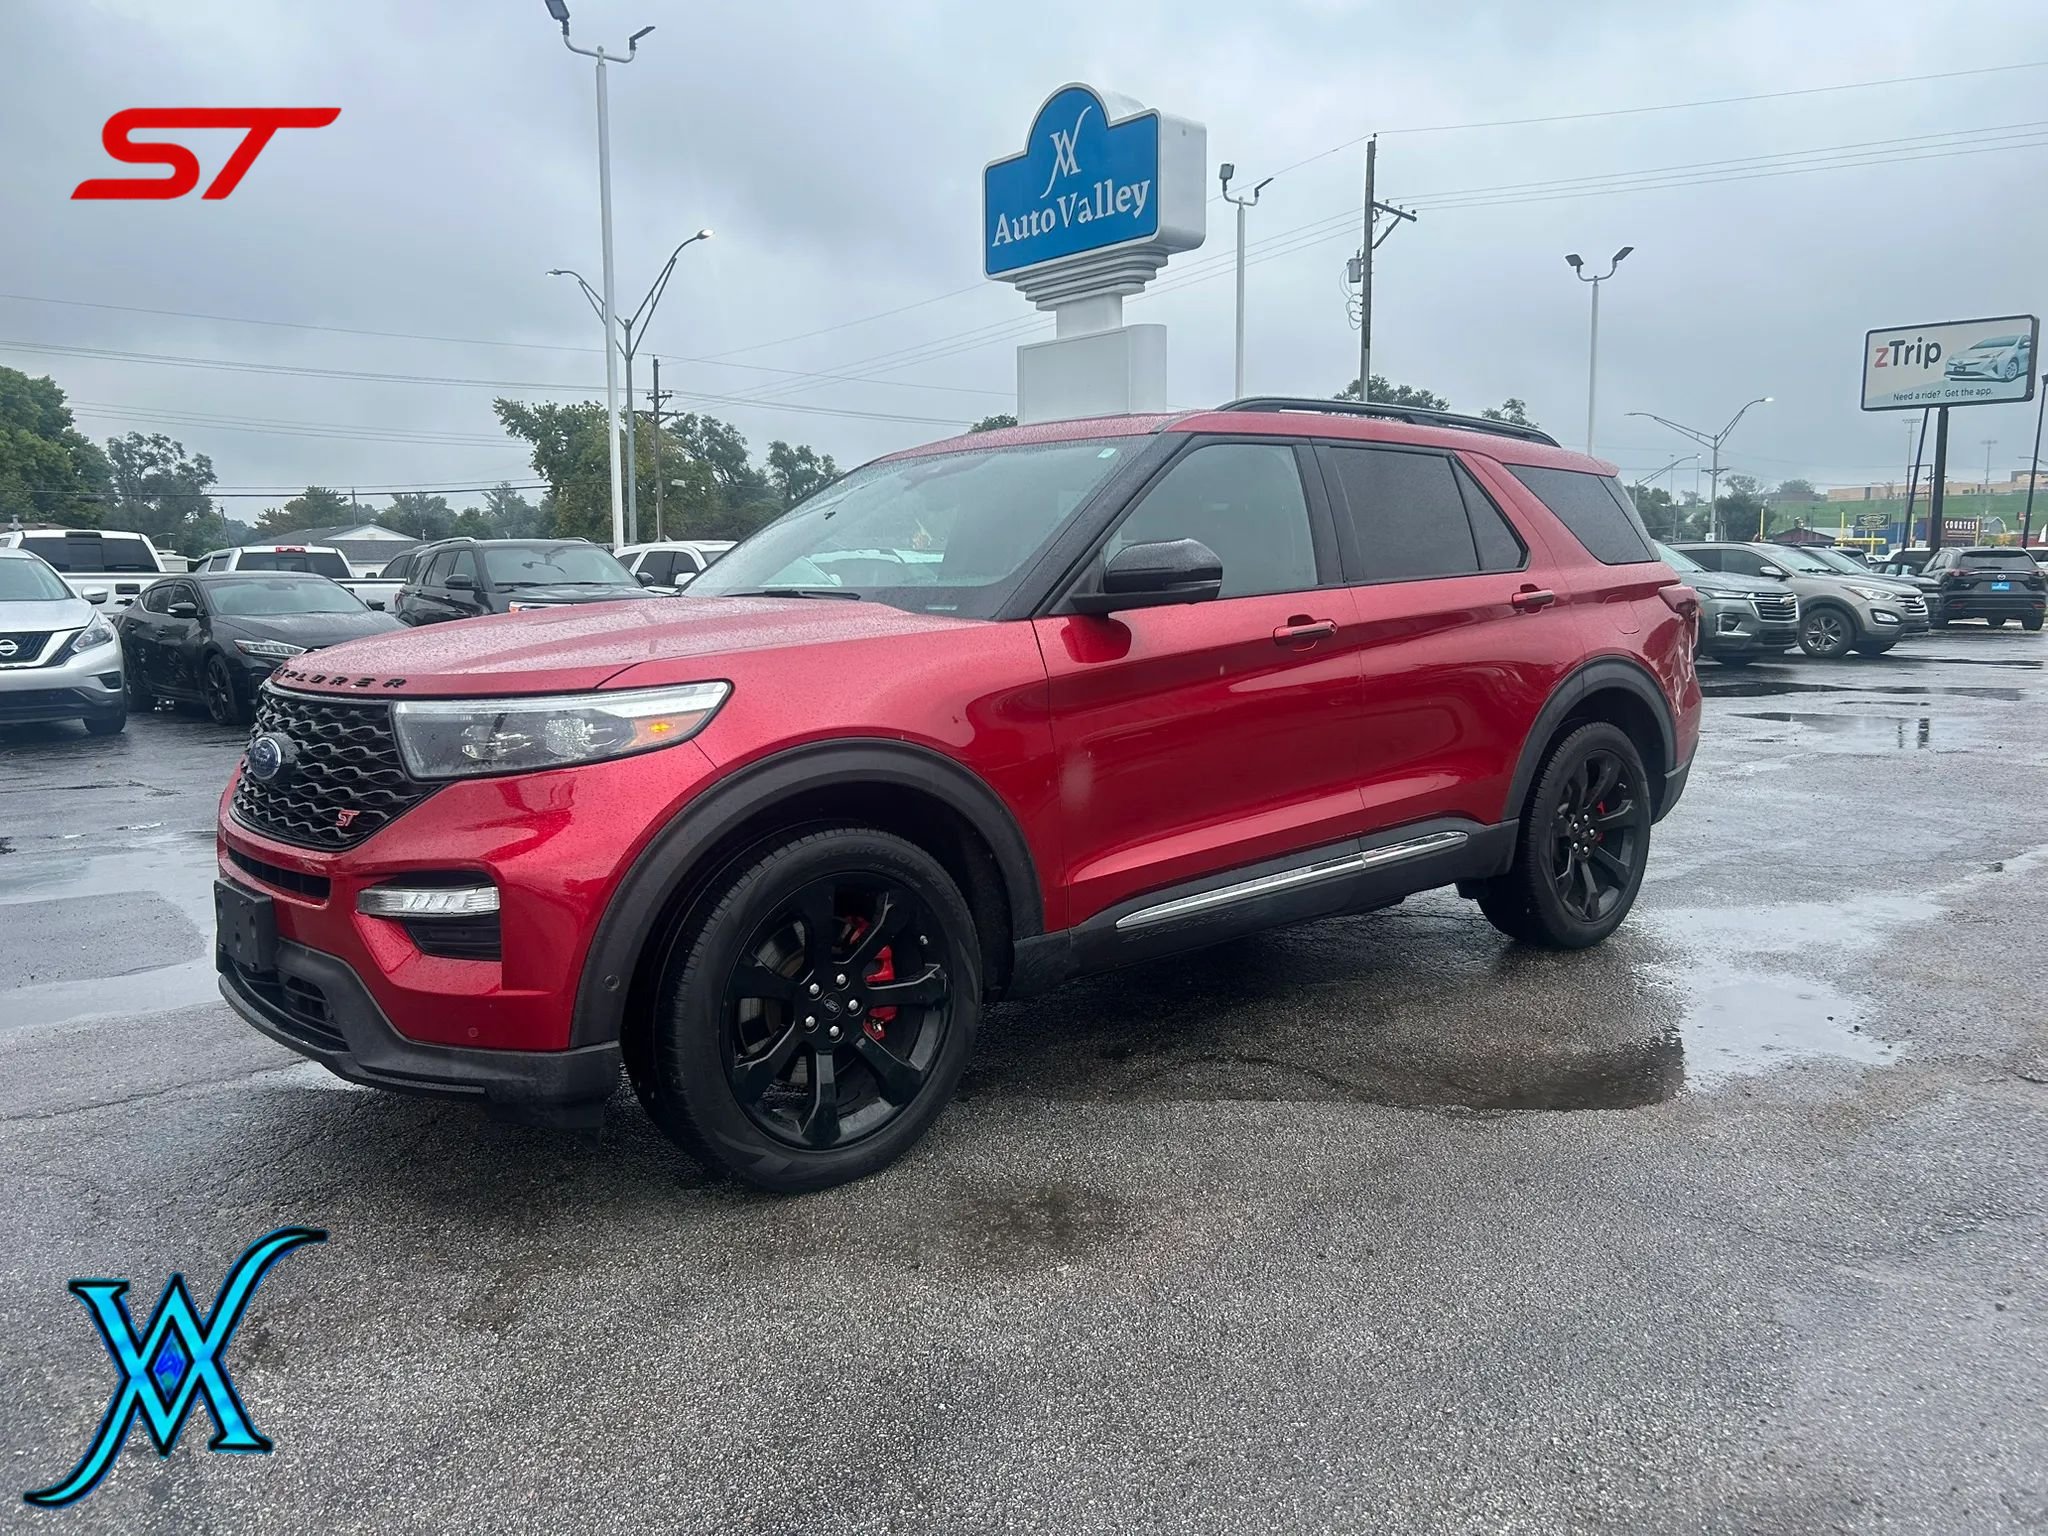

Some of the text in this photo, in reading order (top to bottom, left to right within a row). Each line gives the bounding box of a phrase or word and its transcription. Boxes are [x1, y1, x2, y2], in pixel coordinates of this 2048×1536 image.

[1874, 336, 1942, 369] zTrip
[1893, 392, 1913, 401] Need
[1922, 390, 1941, 399] ride?
[1945, 389, 1959, 398] Get
[1961, 388, 1974, 396] the
[1976, 387, 1993, 396] app.
[1945, 520, 1979, 530] COURTES
[336, 809, 360, 826] ST
